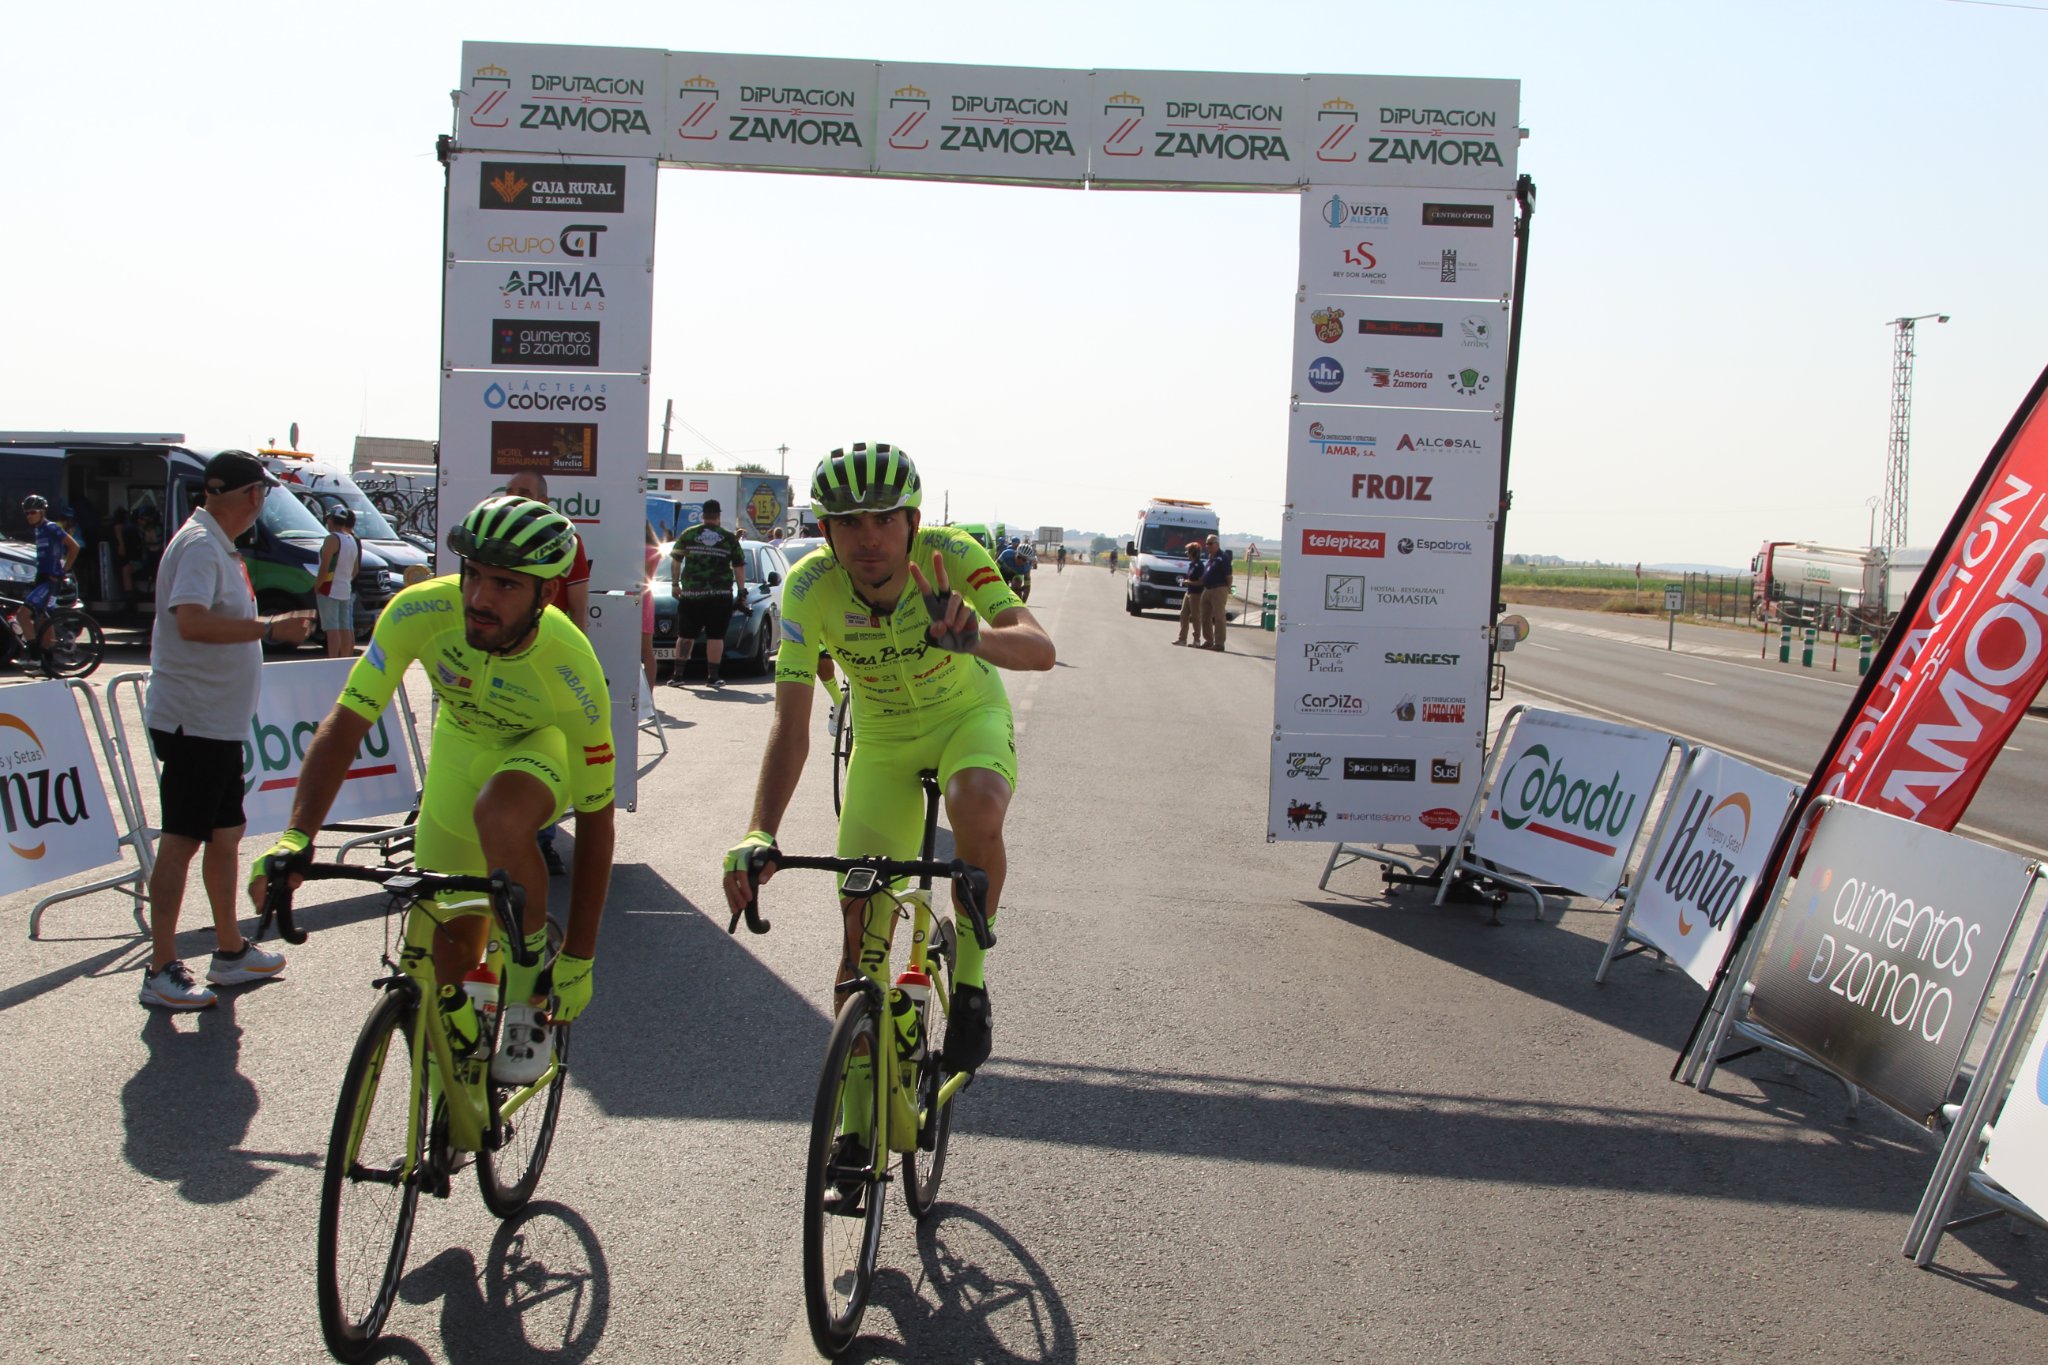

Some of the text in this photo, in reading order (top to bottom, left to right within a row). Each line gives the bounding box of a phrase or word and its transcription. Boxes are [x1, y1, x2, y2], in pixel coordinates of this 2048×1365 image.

[520, 104, 651, 135] ZAMORA
[728, 115, 862, 147] ZAMORA
[940, 125, 1076, 156] ZAMORA
[1154, 131, 1290, 161] ZAMORA
[1368, 137, 1504, 167] ZAMORA
[532, 181, 616, 195] CAJA RURAL
[532, 196, 583, 205] DE ZAMORA
[1350, 206, 1389, 217] VISTA
[1431, 211, 1491, 220] CENTRO ÓPTICO
[1350, 216, 1389, 225] ALEGRE
[488, 236, 555, 254] GRUPO
[1361, 272, 1387, 280] SANCHO
[502, 270, 605, 298] ARIMA
[504, 299, 605, 311] SEMILLAS
[520, 330, 591, 344] alimentos
[533, 344, 591, 356] zamora
[1393, 368, 1433, 379] Asesoría
[508, 380, 607, 393] LÁCTEAS
[1393, 379, 1428, 389] Zamora
[508, 392, 607, 412] cobreros
[1416, 437, 1481, 449] ALCOSAL
[1352, 473, 1434, 501] FROIZ
[1308, 533, 1379, 552] telepizza
[1417, 539, 1472, 551] Espabrok
[1377, 594, 1438, 606] TOMASITA
[1304, 643, 1342, 658] Puente
[1309, 658, 1344, 673] Piedra
[1879, 512, 2048, 822] AMOR
[6, 756, 13, 770] y
[14, 750, 42, 765] Setas
[1434, 765, 1458, 779] Susi
[1501, 744, 1637, 837] Cobadu
[0, 766, 90, 833] nza
[1833, 877, 1981, 978] alimentos
[1829, 943, 1954, 1045] zamora
